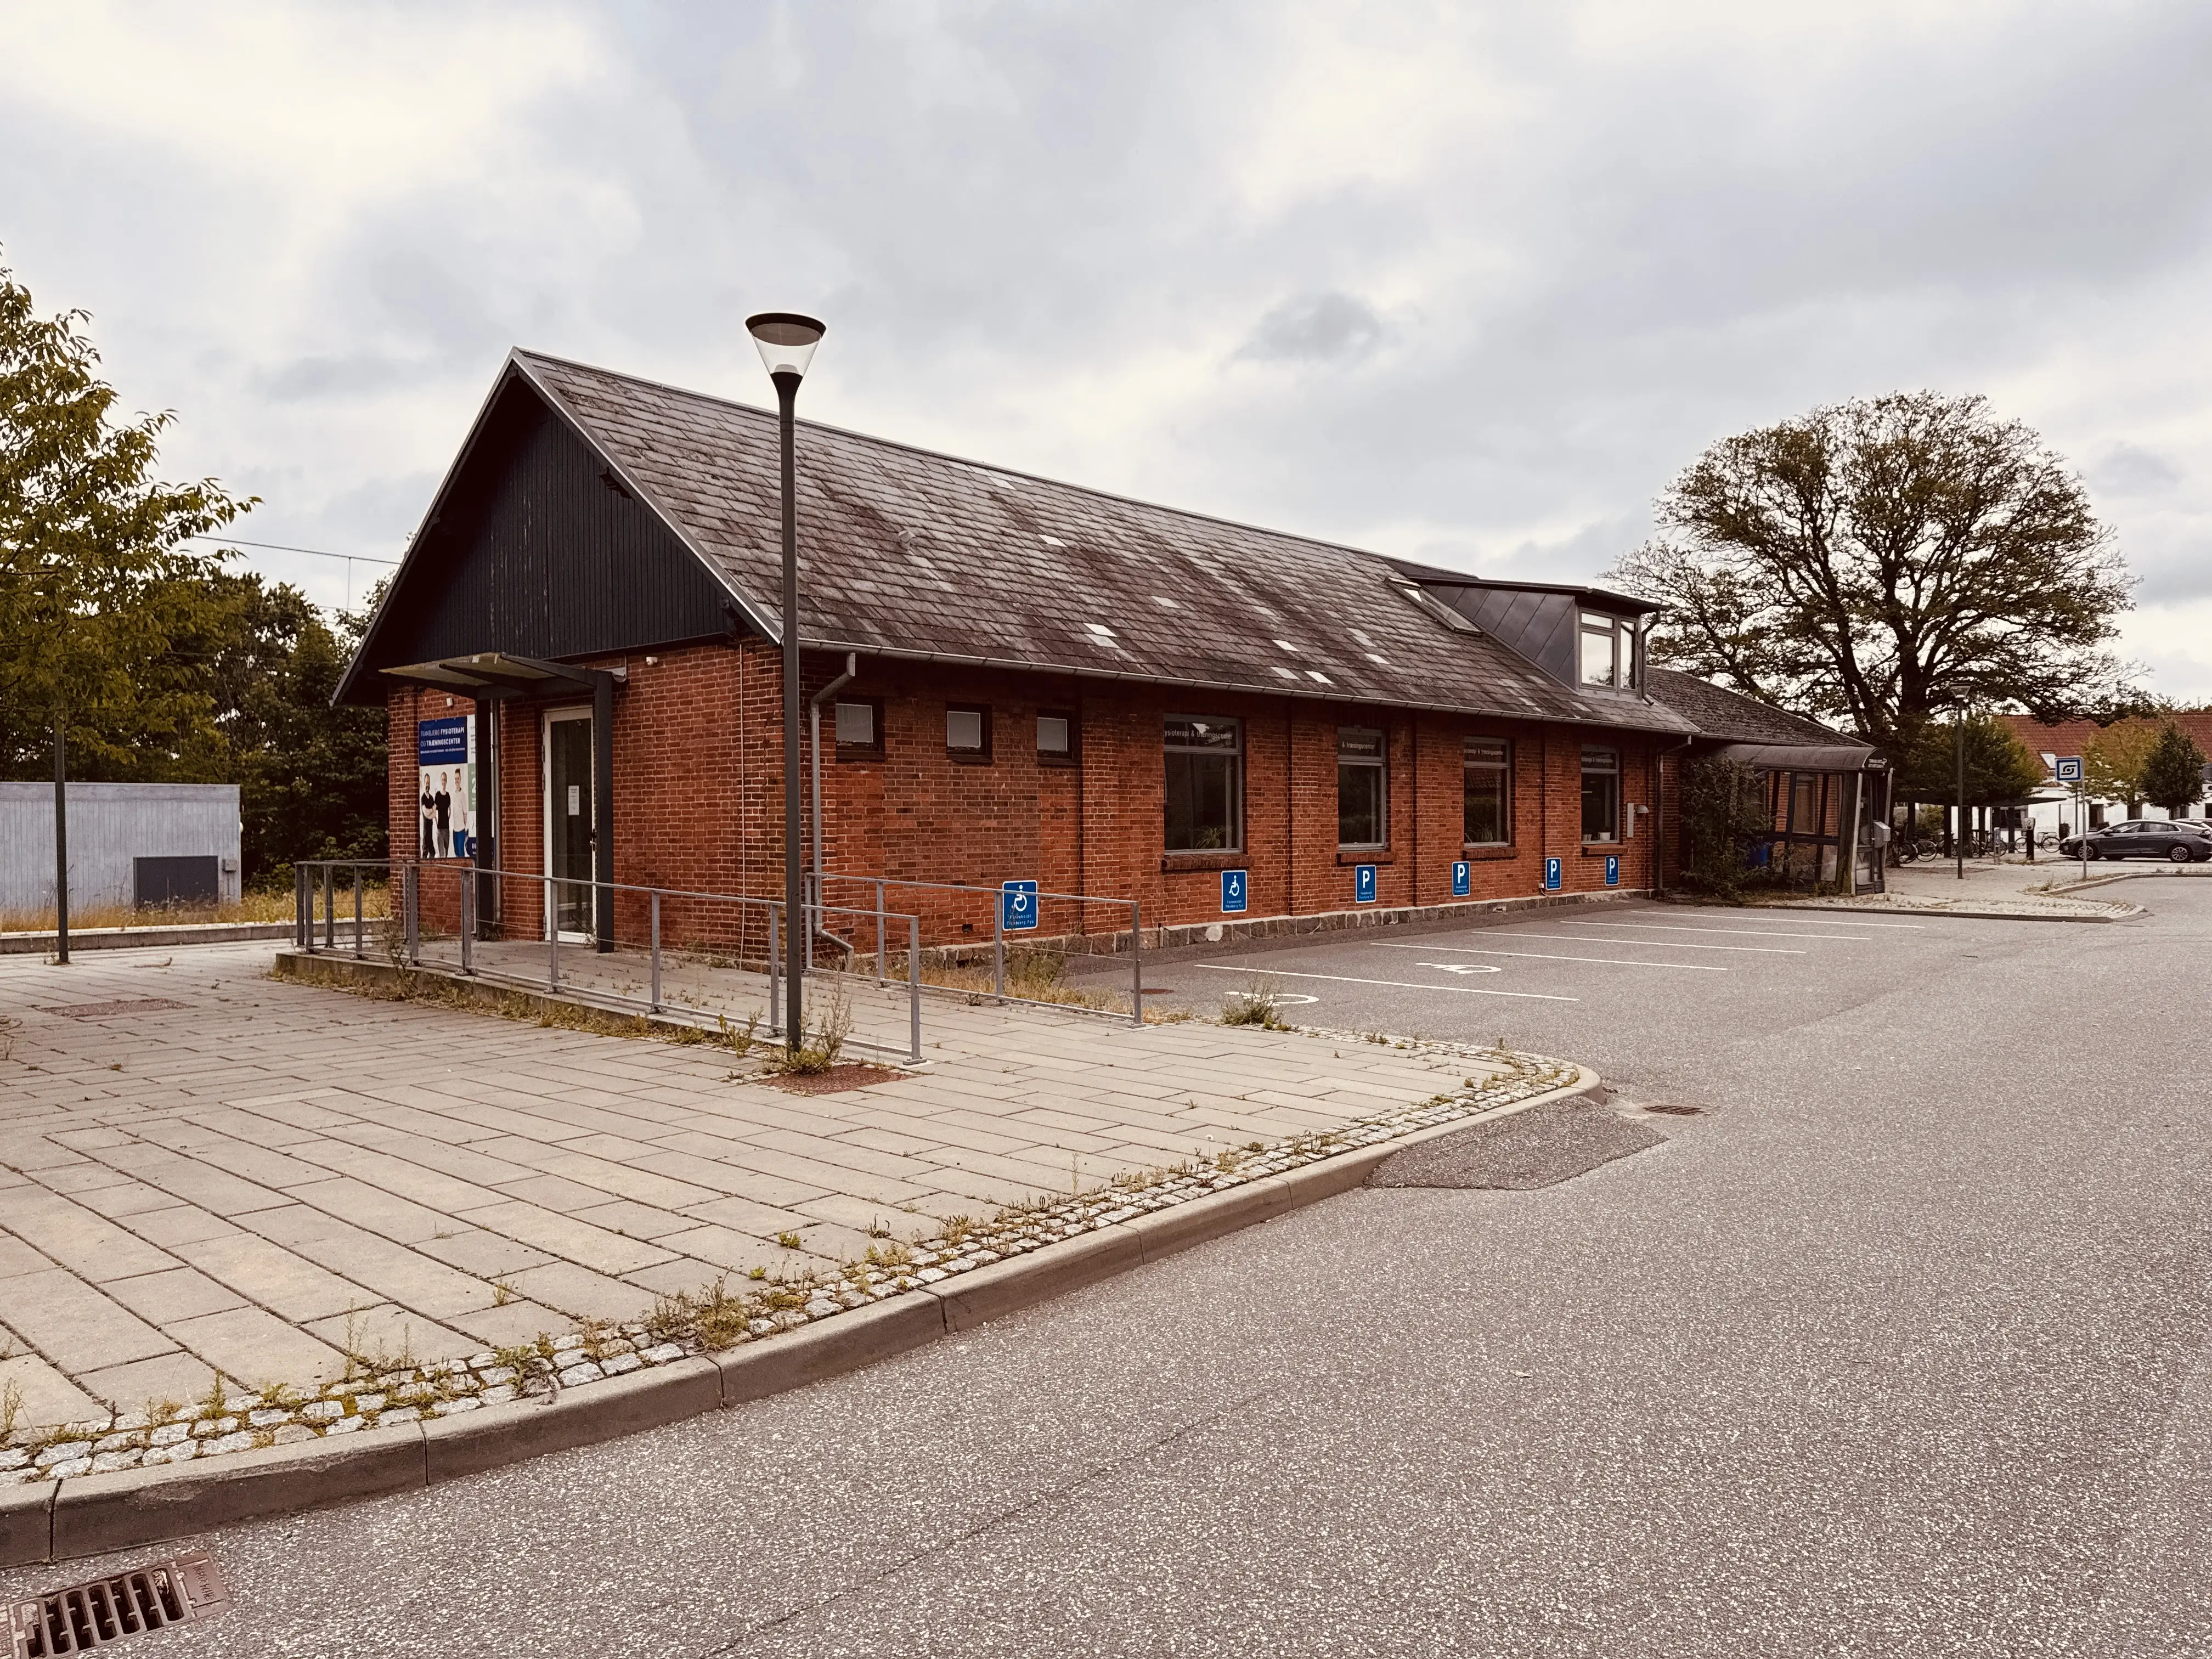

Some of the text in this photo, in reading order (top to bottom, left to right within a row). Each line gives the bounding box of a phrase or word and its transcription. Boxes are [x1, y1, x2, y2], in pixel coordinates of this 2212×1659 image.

[441, 727, 465, 735] FYSIOTERAPI
[426, 737, 460, 747] TRÆNINGSCENTER
[1458, 864, 1465, 884] P
[1551, 860, 1557, 878] P
[1610, 858, 1615, 875] P
[1363, 870, 1370, 889] P
